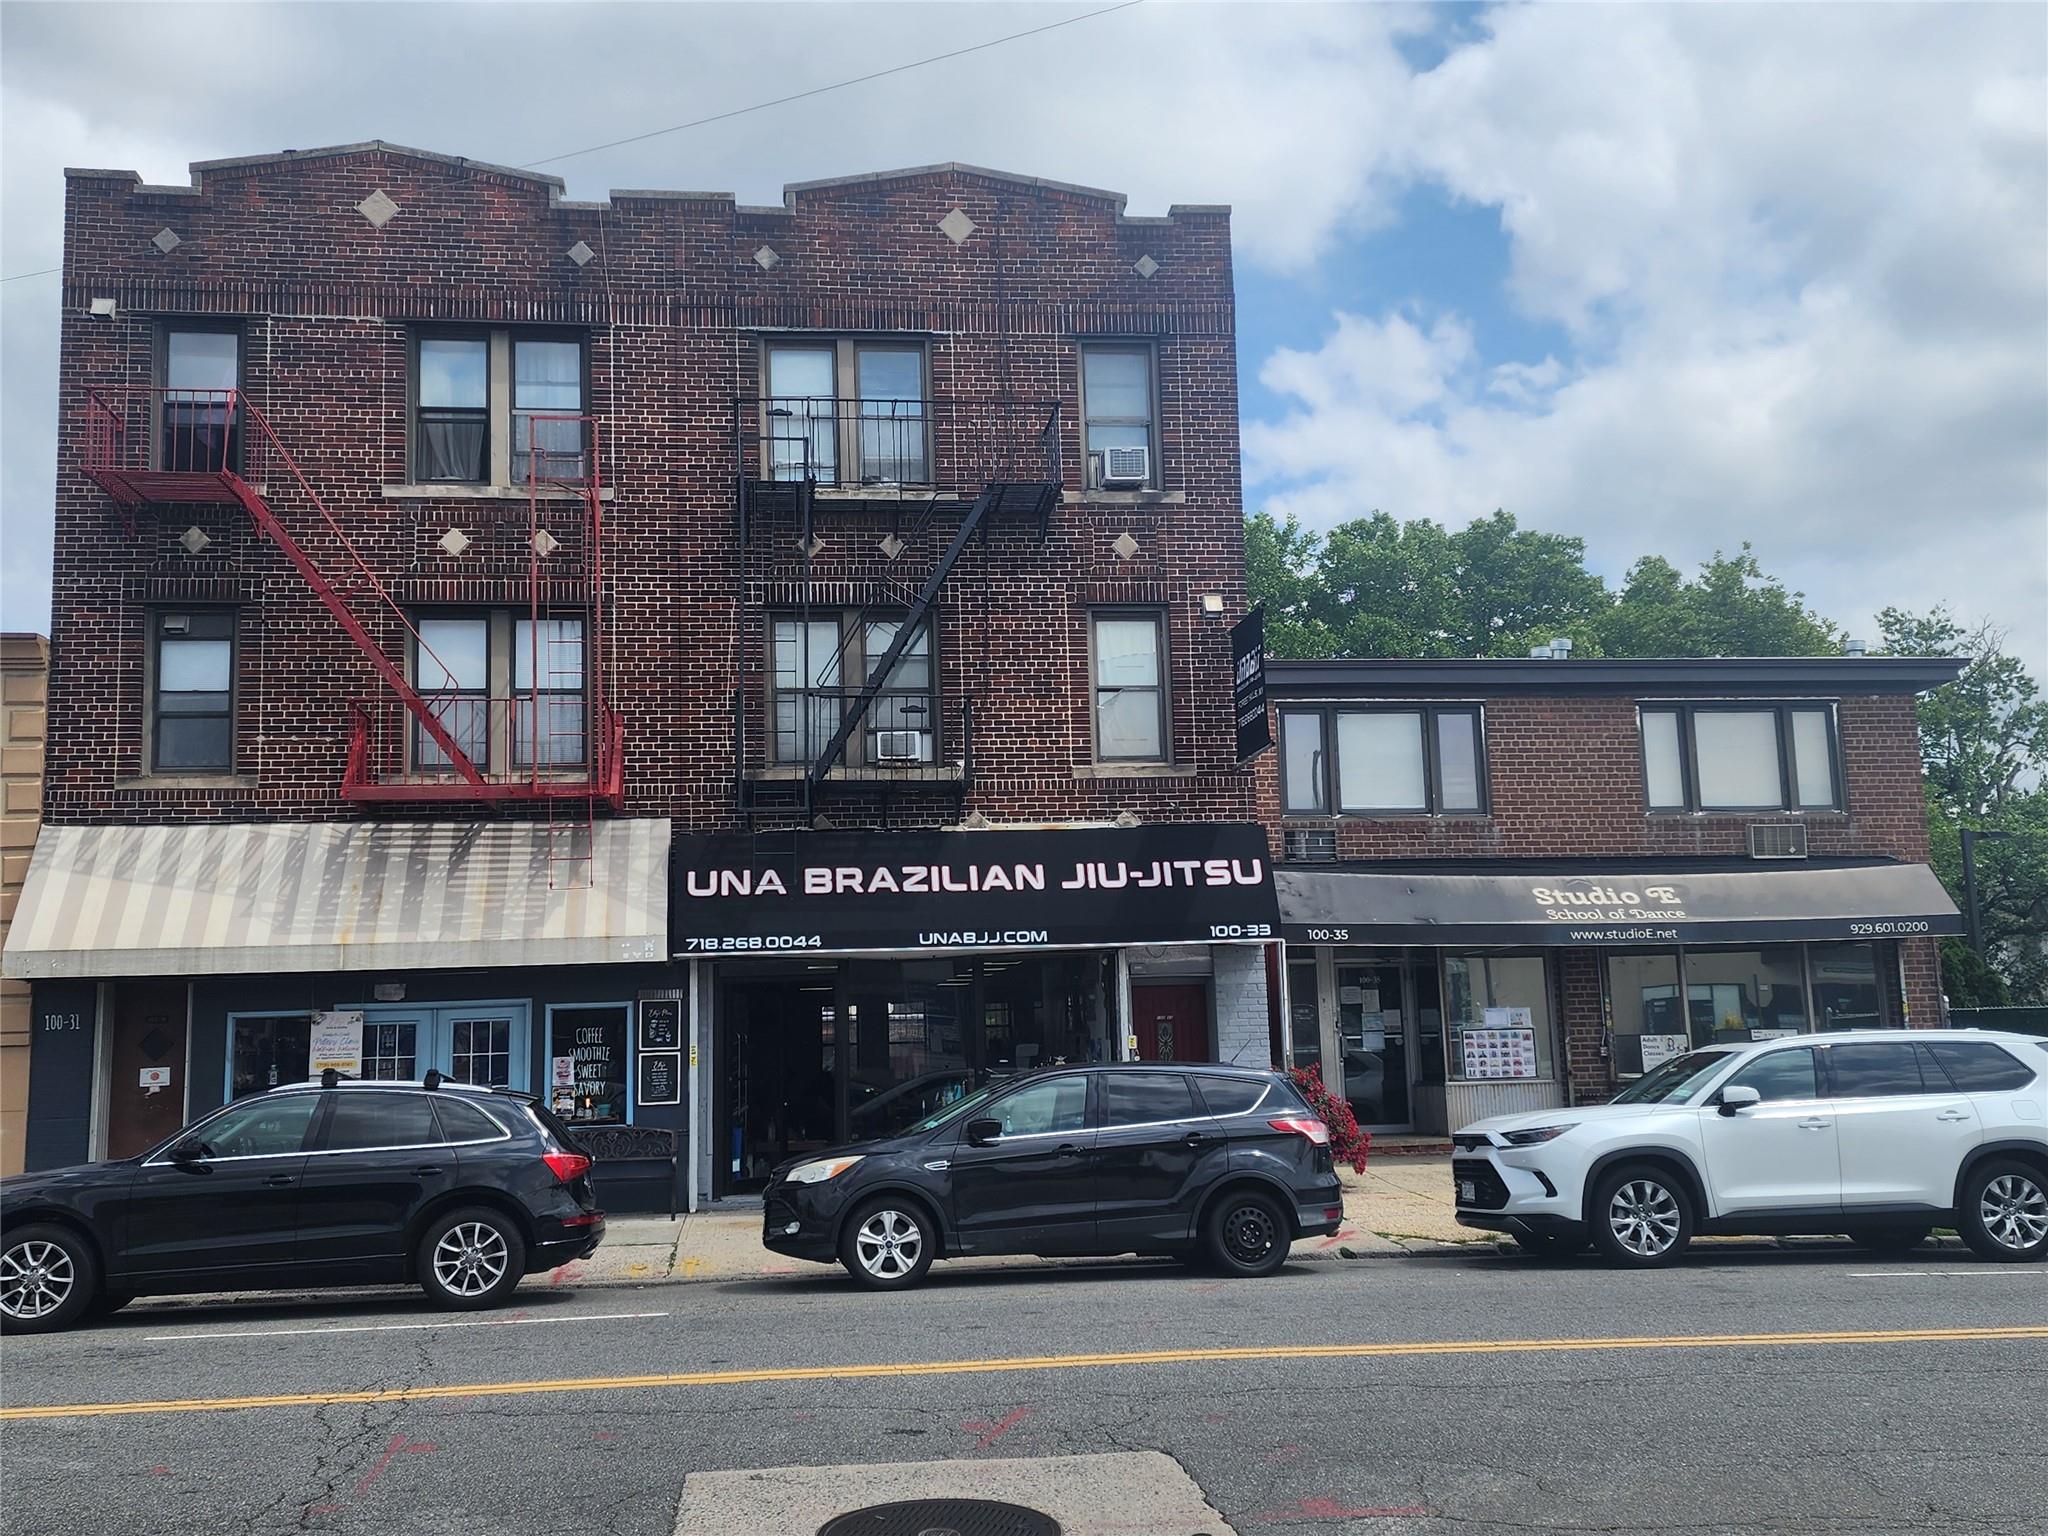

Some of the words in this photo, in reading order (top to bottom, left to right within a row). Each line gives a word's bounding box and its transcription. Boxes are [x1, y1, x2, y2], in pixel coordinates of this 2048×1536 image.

[687, 868, 787, 897] UNA
[803, 864, 1045, 894] BRAZILIAN
[1061, 858, 1263, 889] JIU-JITSU
[1532, 886, 1641, 905] Studio
[1645, 886, 1682, 904] E
[1546, 909, 1605, 920] School
[1609, 909, 1625, 919] of
[1629, 908, 1687, 919] Dance
[1209, 924, 1271, 938] 100-33
[1307, 929, 1349, 940] 100-35
[1570, 928, 1678, 940] www.studioE.net
[1850, 921, 1929, 934] 929.601.0200
[685, 934, 822, 950] 718.268.0044
[919, 931, 1048, 945] UNABJJ.COM
[44, 1013, 81, 1031] 100-31
[576, 1027, 603, 1044] COFFEE
[568, 1046, 611, 1062] SMOOTHIE
[576, 1063, 602, 1079] SWEET
[573, 1081, 606, 1097] SAVORY
